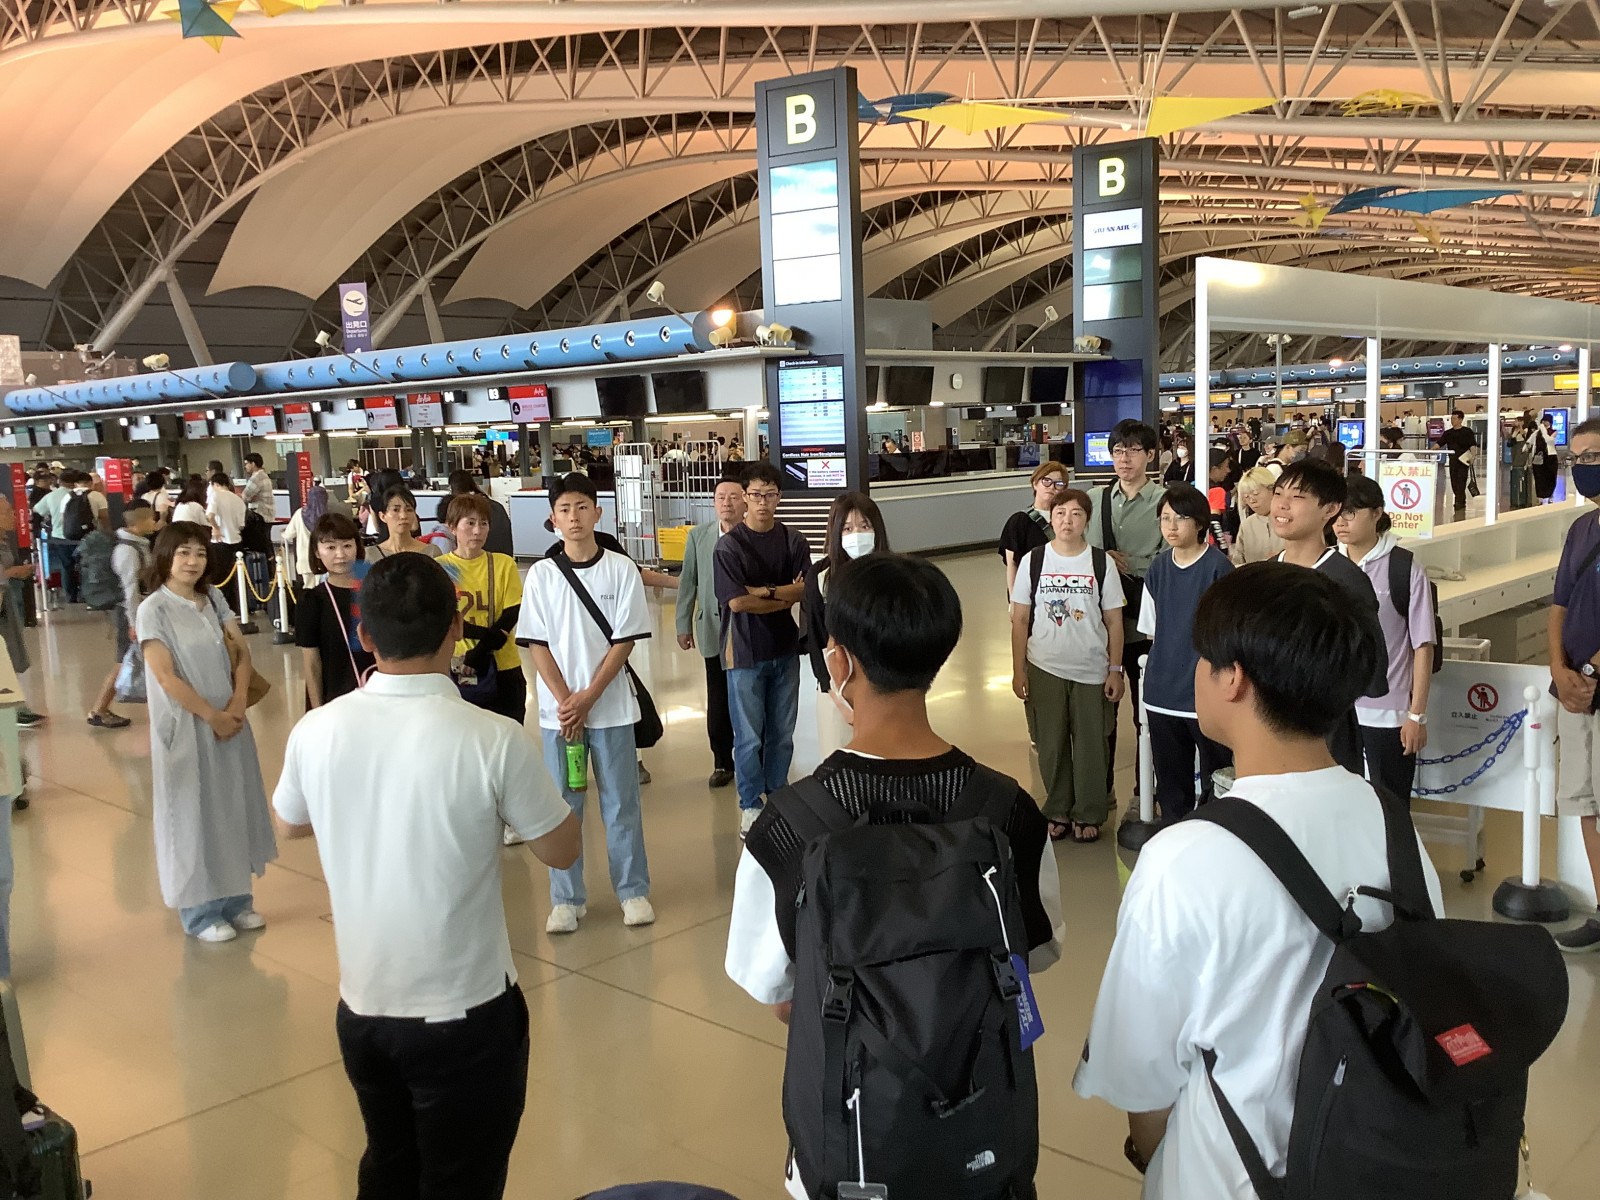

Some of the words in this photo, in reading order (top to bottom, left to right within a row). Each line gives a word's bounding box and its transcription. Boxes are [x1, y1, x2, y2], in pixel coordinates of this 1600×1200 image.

[785, 93, 817, 145] B
[1098, 156, 1126, 197] B
[1383, 465, 1432, 477] 立入禁止
[1388, 511, 1402, 520] Do
[1404, 512, 1424, 521] Not
[1392, 520, 1419, 529] Enter
[1040, 575, 1093, 588] ROCK
[1451, 711, 1478, 720] 立入禁止
